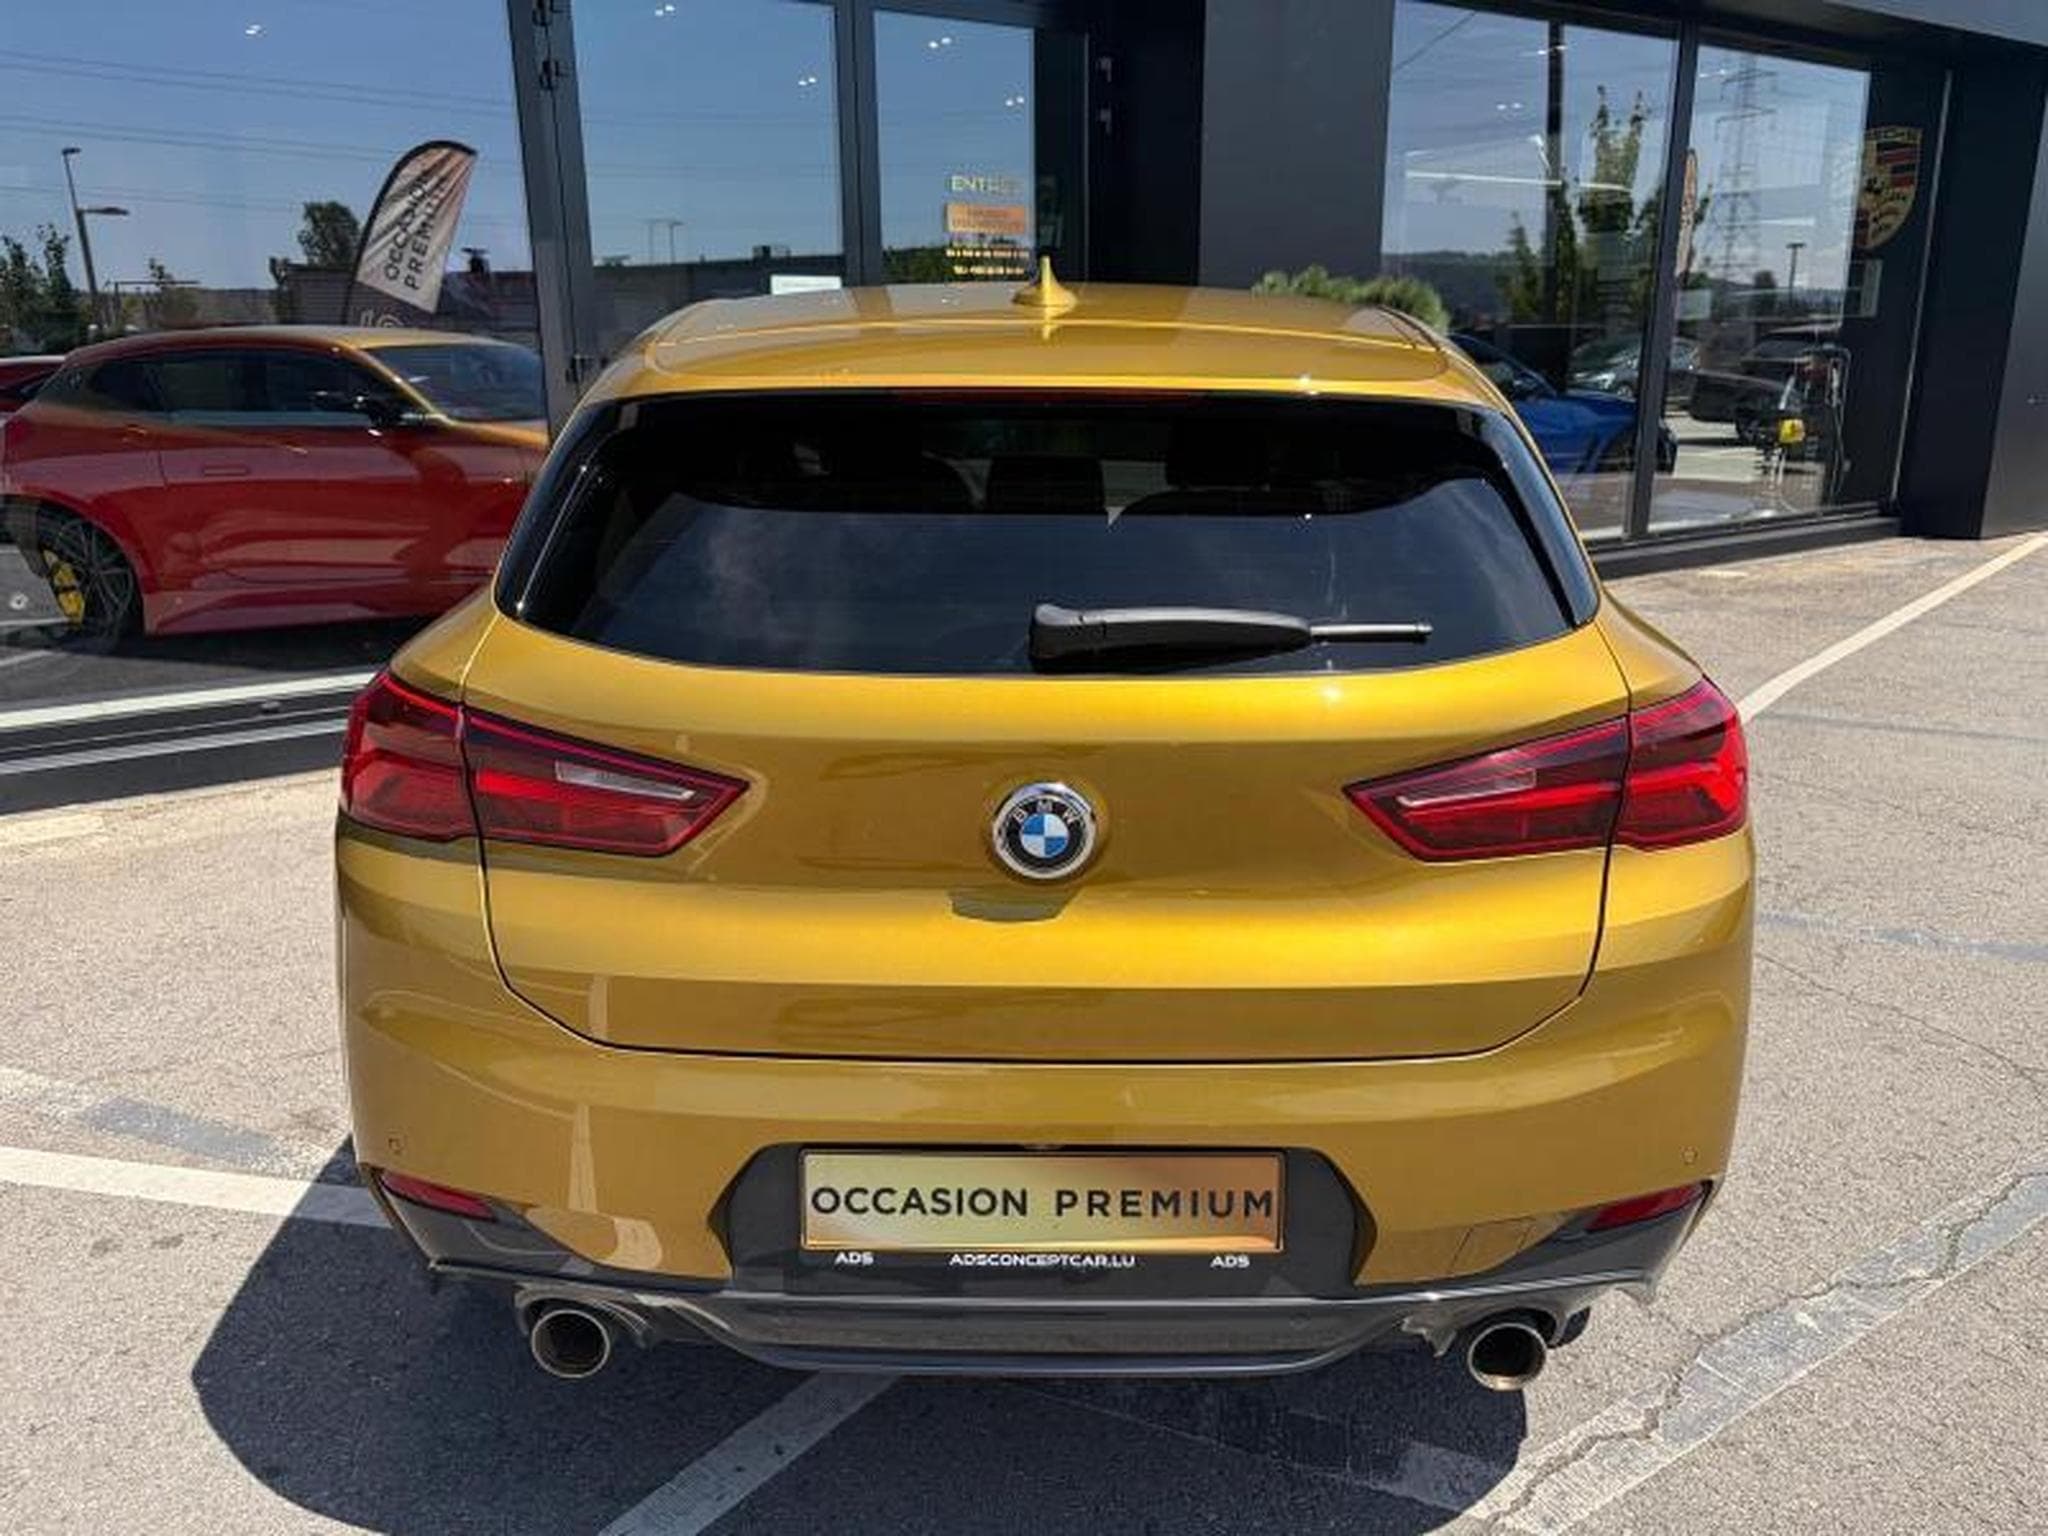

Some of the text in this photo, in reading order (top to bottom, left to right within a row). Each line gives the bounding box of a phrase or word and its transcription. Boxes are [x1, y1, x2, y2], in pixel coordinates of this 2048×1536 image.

[1012, 799, 1080, 823] BMW
[811, 1187, 1273, 1218] OCCASION PREMIUM
[835, 1251, 1250, 1269] ADS ADSCONCEPTCAR.LU ADS
